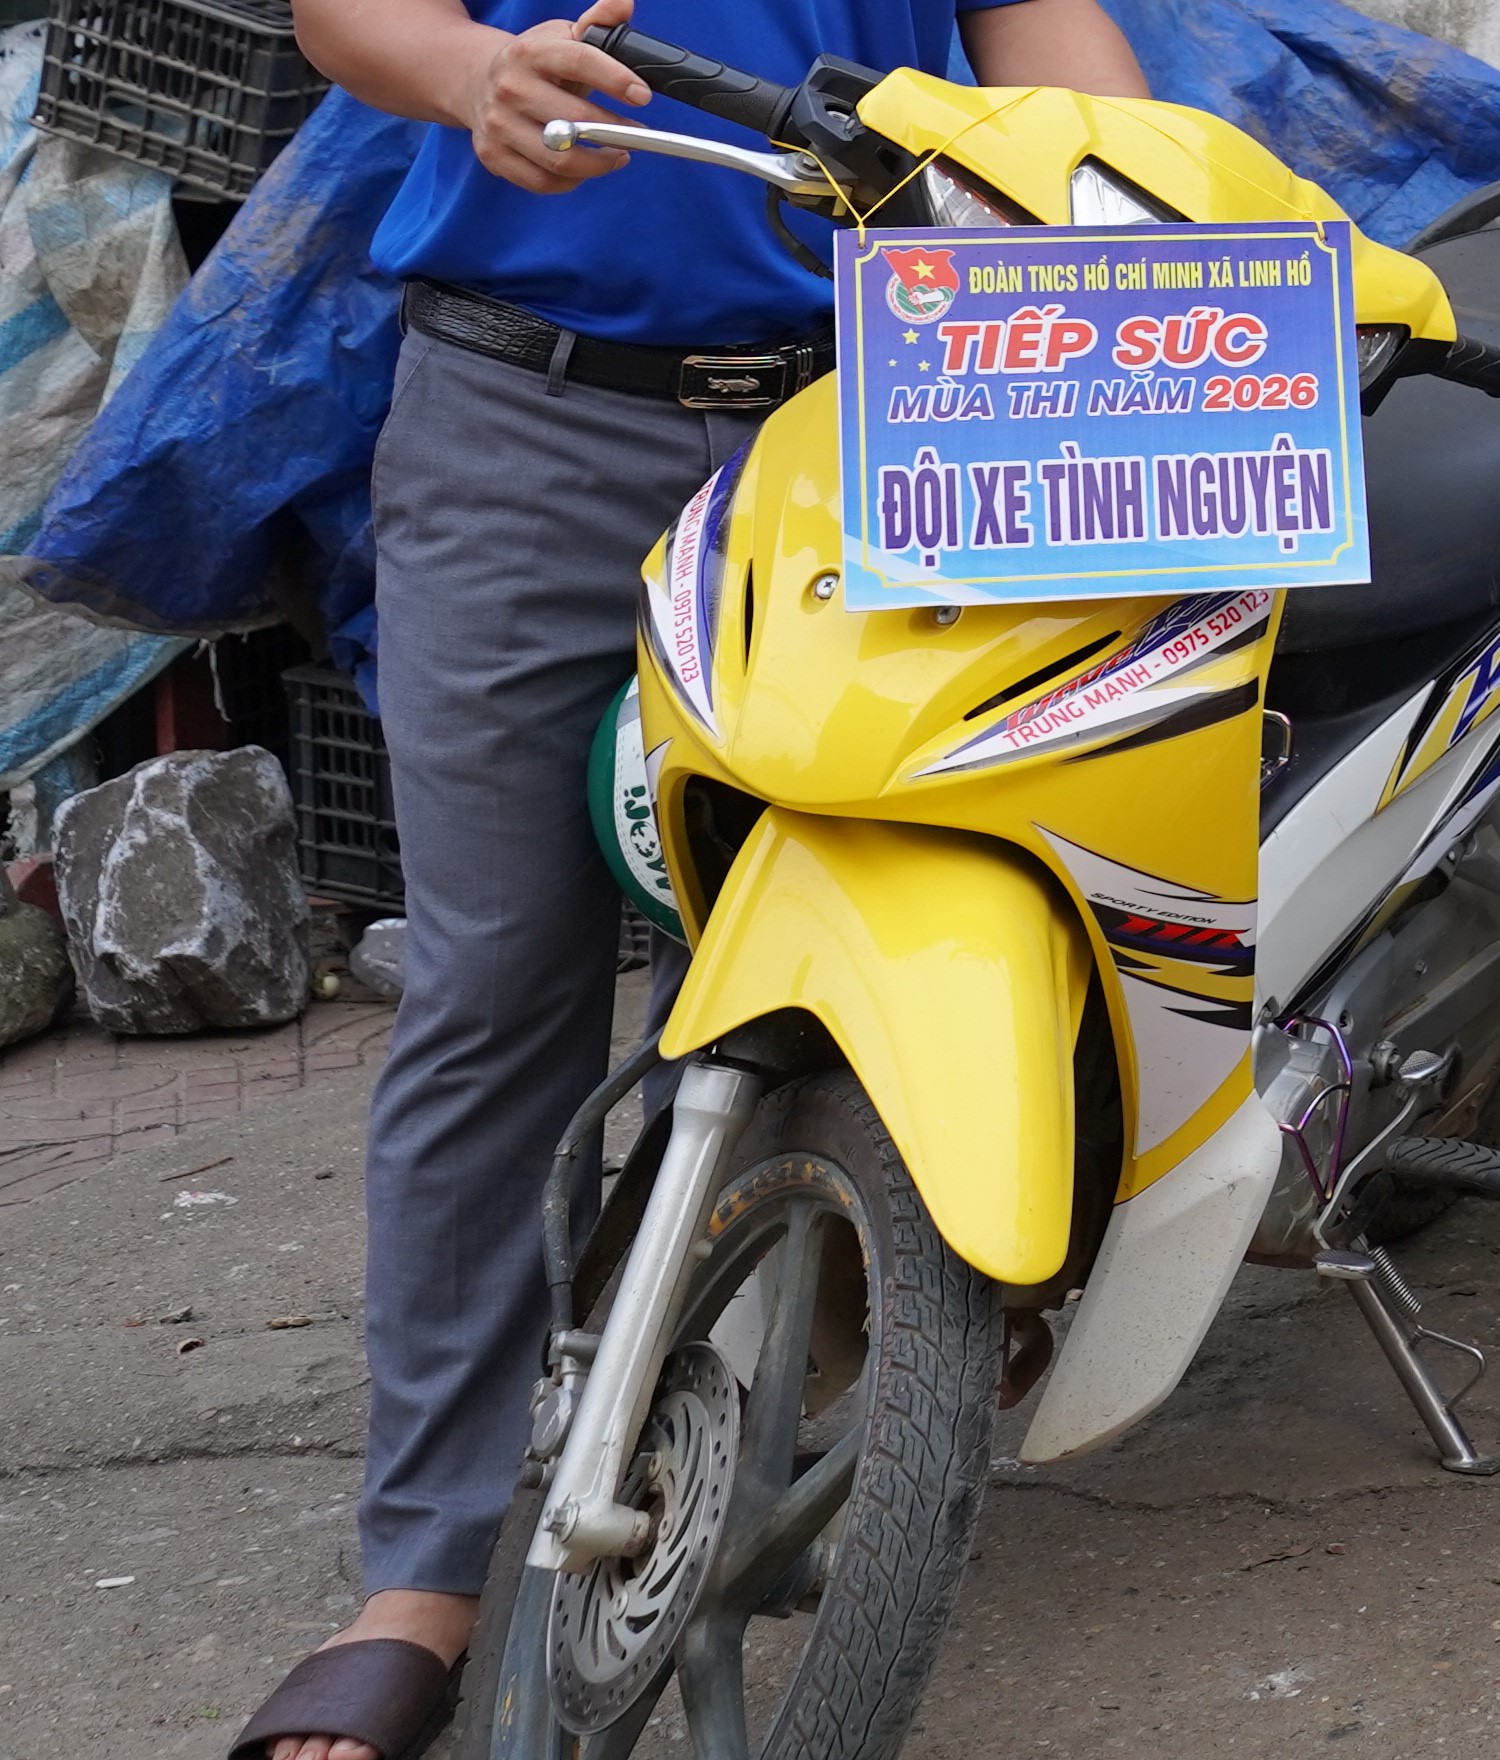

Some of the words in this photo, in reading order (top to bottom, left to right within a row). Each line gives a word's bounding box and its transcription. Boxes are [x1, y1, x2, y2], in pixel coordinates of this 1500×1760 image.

[969, 259, 1022, 294] ĐOÀN
[1028, 264, 1078, 293] TNCS
[1085, 255, 1108, 292] HỒ
[1115, 260, 1146, 290] CHÍ
[1153, 259, 1202, 289] MINH
[1208, 257, 1232, 288] XÃ
[1240, 258, 1281, 288] LINH
[1287, 251, 1312, 287] HỒ
[939, 304, 1098, 376] TIẾP
[1112, 305, 1269, 371] SỨC
[888, 376, 993, 423] MÙA
[1007, 381, 1078, 419] THI
[1088, 371, 1195, 415] NĂM
[1202, 374, 1319, 412] 2026
[879, 446, 959, 569] ĐỘI
[969, 460, 1033, 549] XE
[1040, 441, 1146, 544] TÌNH
[1154, 433, 1333, 553] NGUYỆN
[1003, 701, 1085, 748] TRUNG
[1084, 664, 1152, 710] MẠNH
[1162, 628, 1210, 665] 0975
[1207, 606, 1242, 637] 520
[1240, 589, 1270, 613] 123
[1090, 892, 1158, 913] SPORTY
[1157, 911, 1216, 924] EDITION
